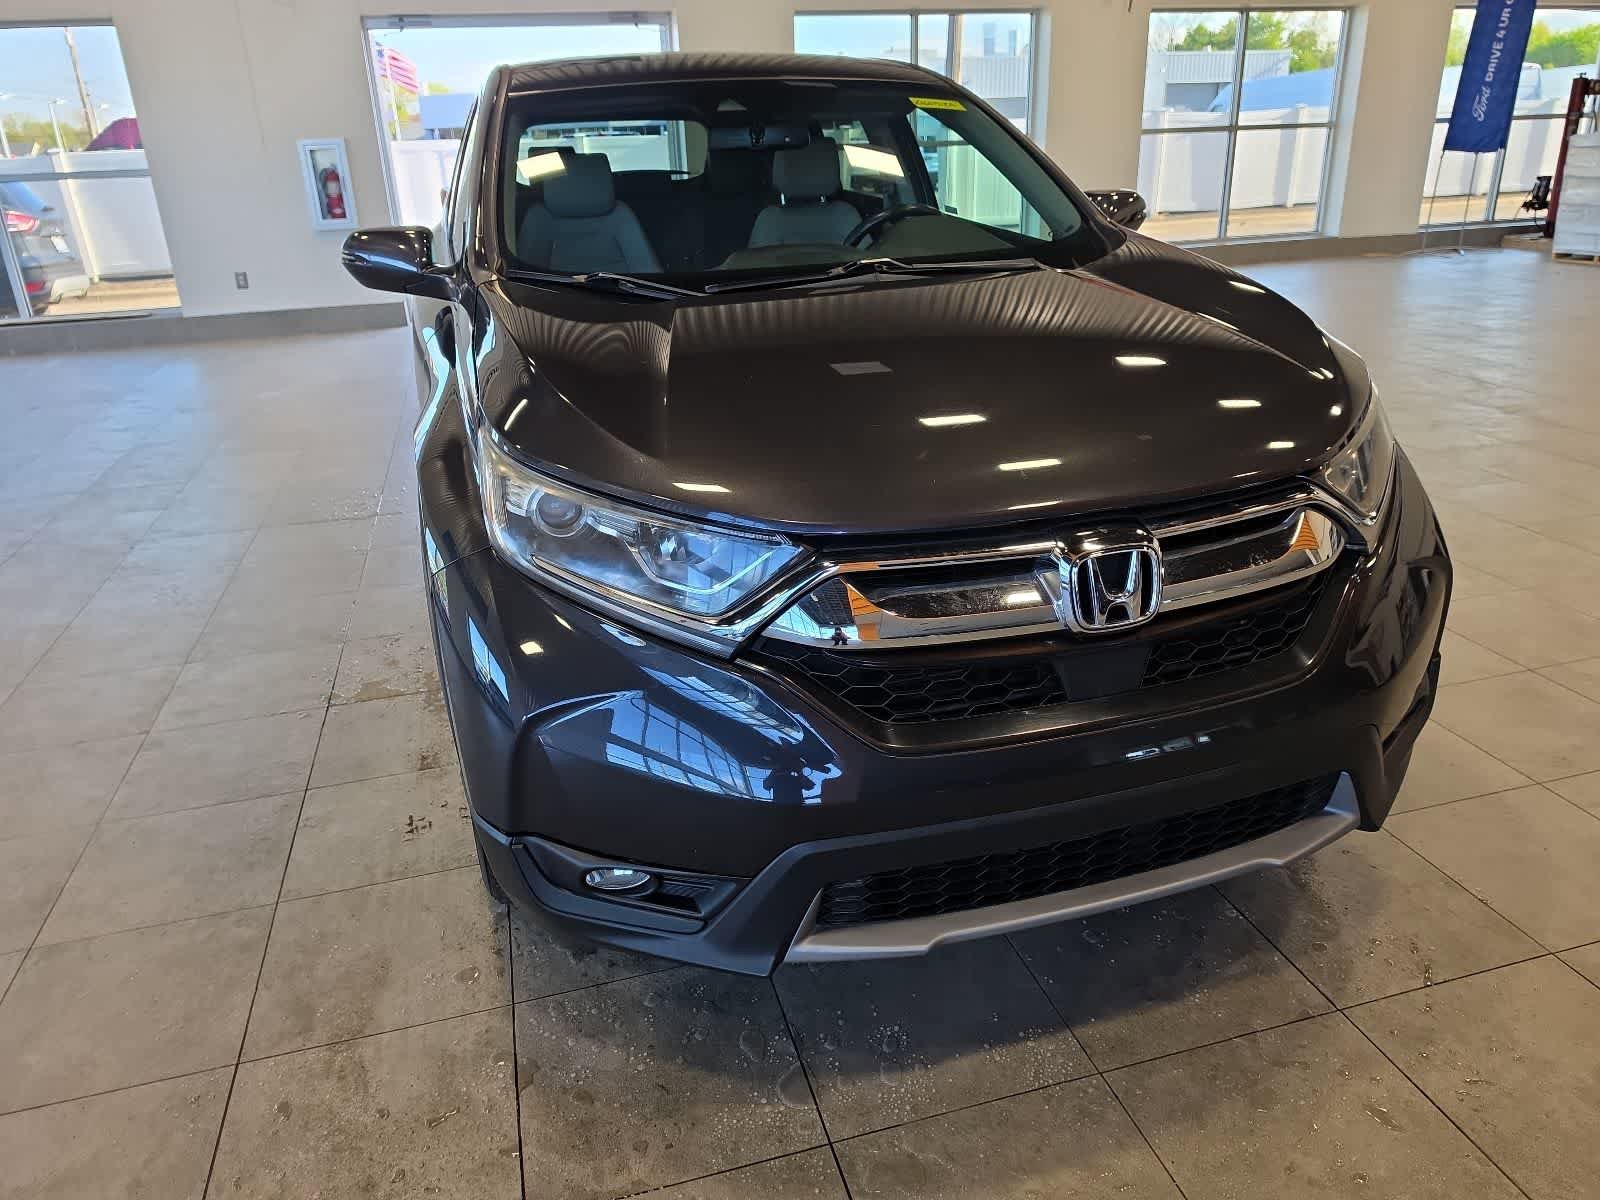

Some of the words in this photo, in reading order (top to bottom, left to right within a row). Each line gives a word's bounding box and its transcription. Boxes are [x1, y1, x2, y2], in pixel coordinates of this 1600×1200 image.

[1498, 8, 1512, 27] UR
[1496, 30, 1506, 38] 4
[1485, 41, 1504, 81] DRIVE
[1472, 86, 1491, 121] Ford
